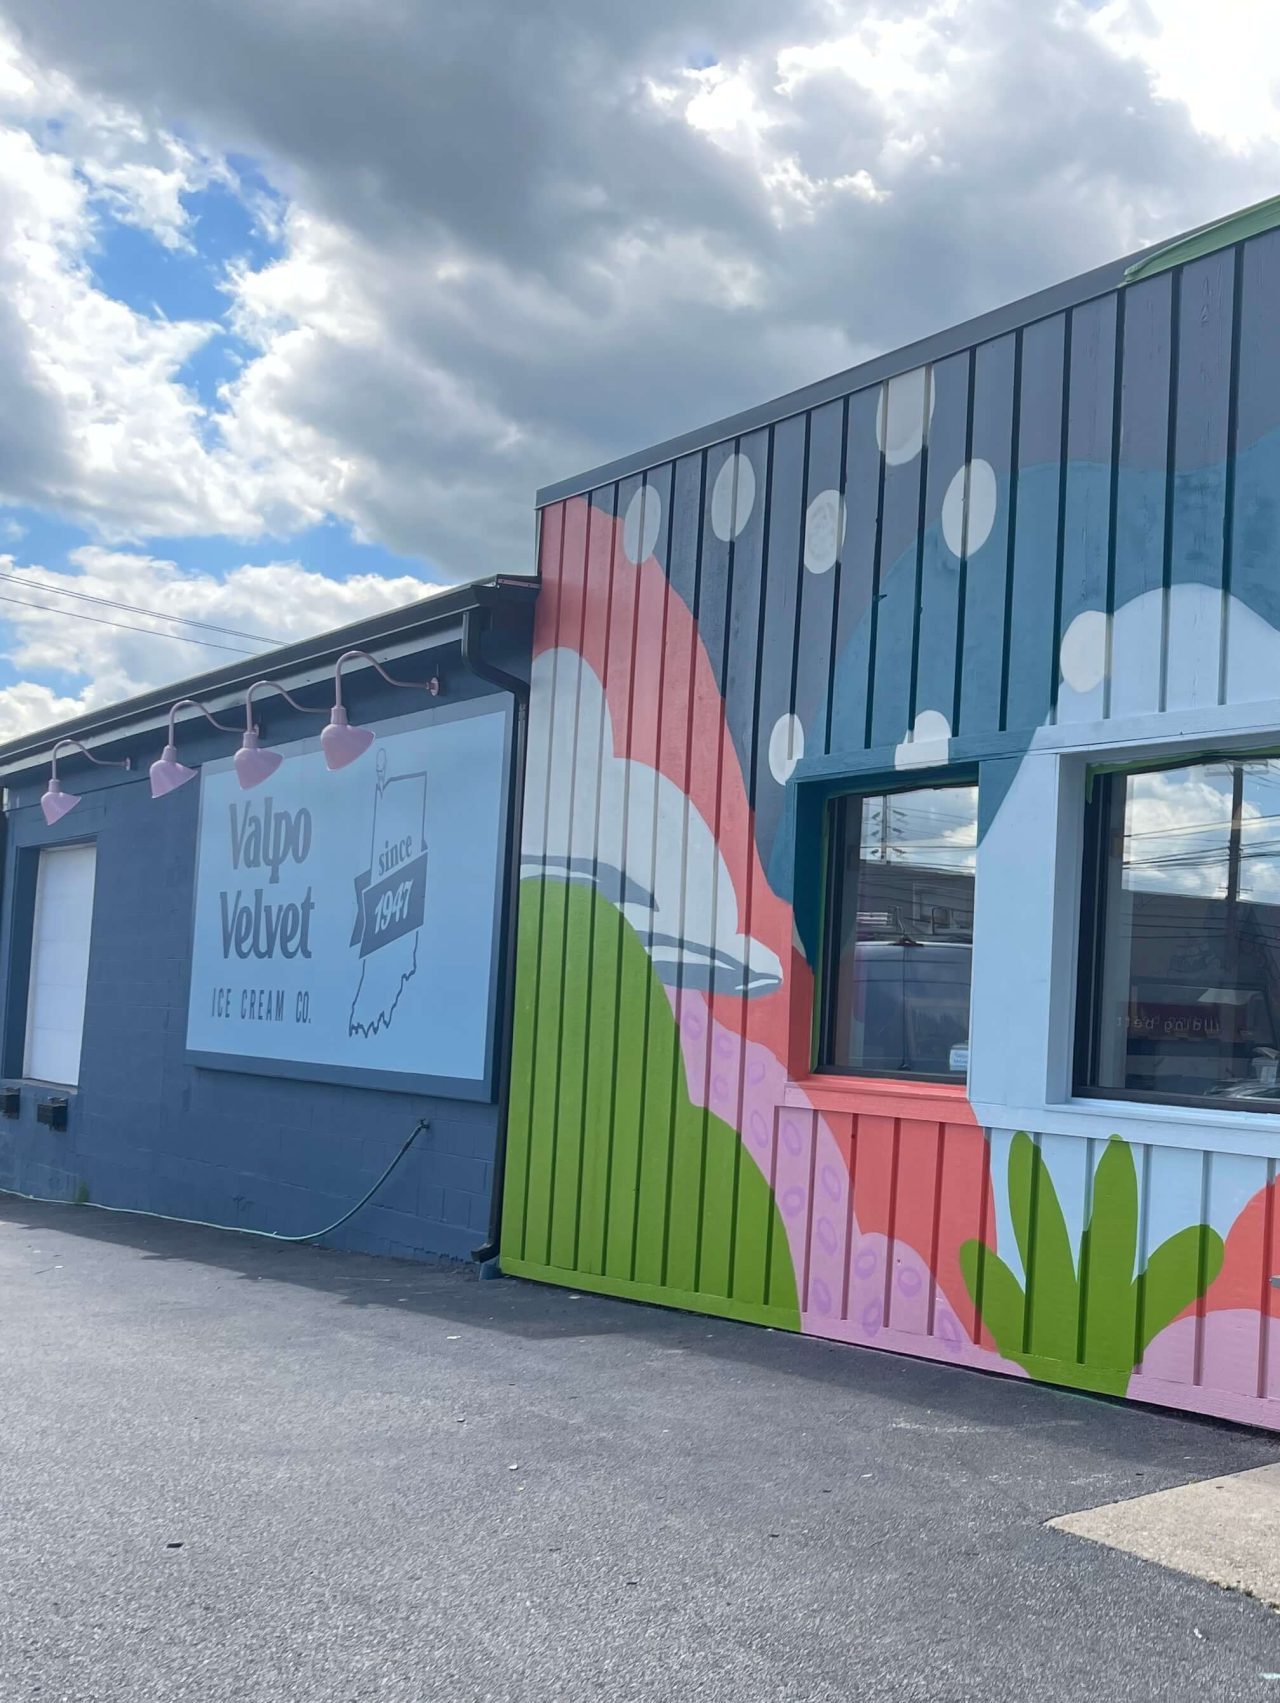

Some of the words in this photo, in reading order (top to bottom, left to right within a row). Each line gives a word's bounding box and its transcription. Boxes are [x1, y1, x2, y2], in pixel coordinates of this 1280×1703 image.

[229, 797, 313, 884] Valpo
[378, 834, 413, 877] since
[219, 886, 315, 959] Velvet
[374, 879, 414, 934] 1947
[211, 988, 231, 1020] ICE
[240, 989, 285, 1023] CREAM
[295, 991, 312, 1025] CO.
